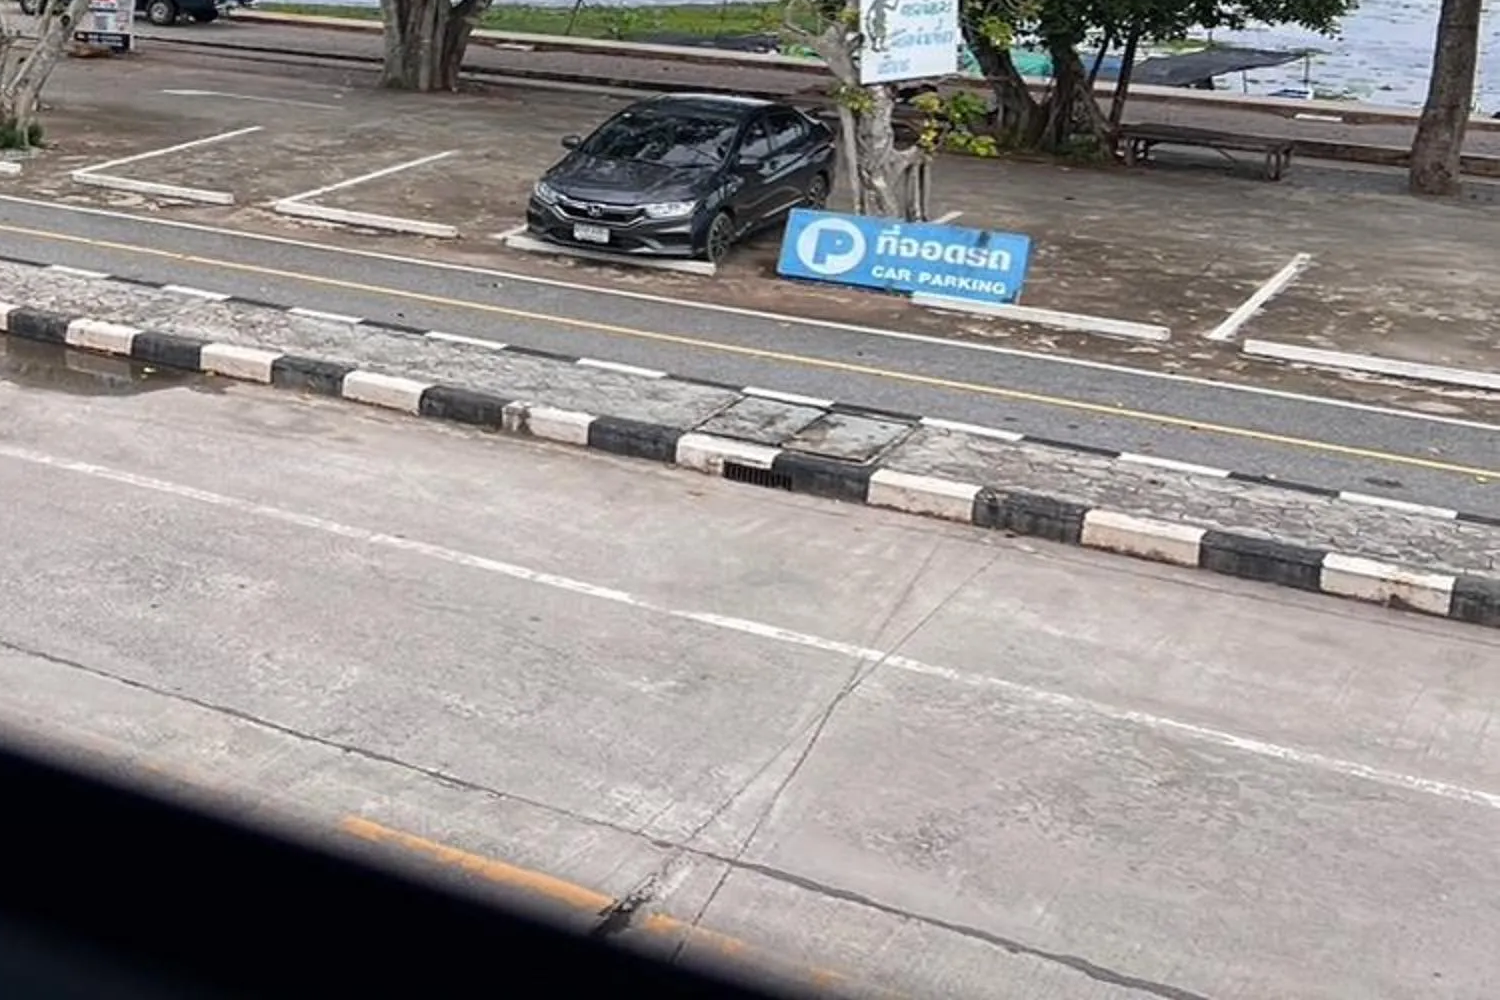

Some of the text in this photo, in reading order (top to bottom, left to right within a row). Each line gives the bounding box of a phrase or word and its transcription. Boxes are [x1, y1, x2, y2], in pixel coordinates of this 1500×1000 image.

[875, 225, 1012, 271] ที่จอดรถ
[871, 265, 1007, 295] CAR PARKING
